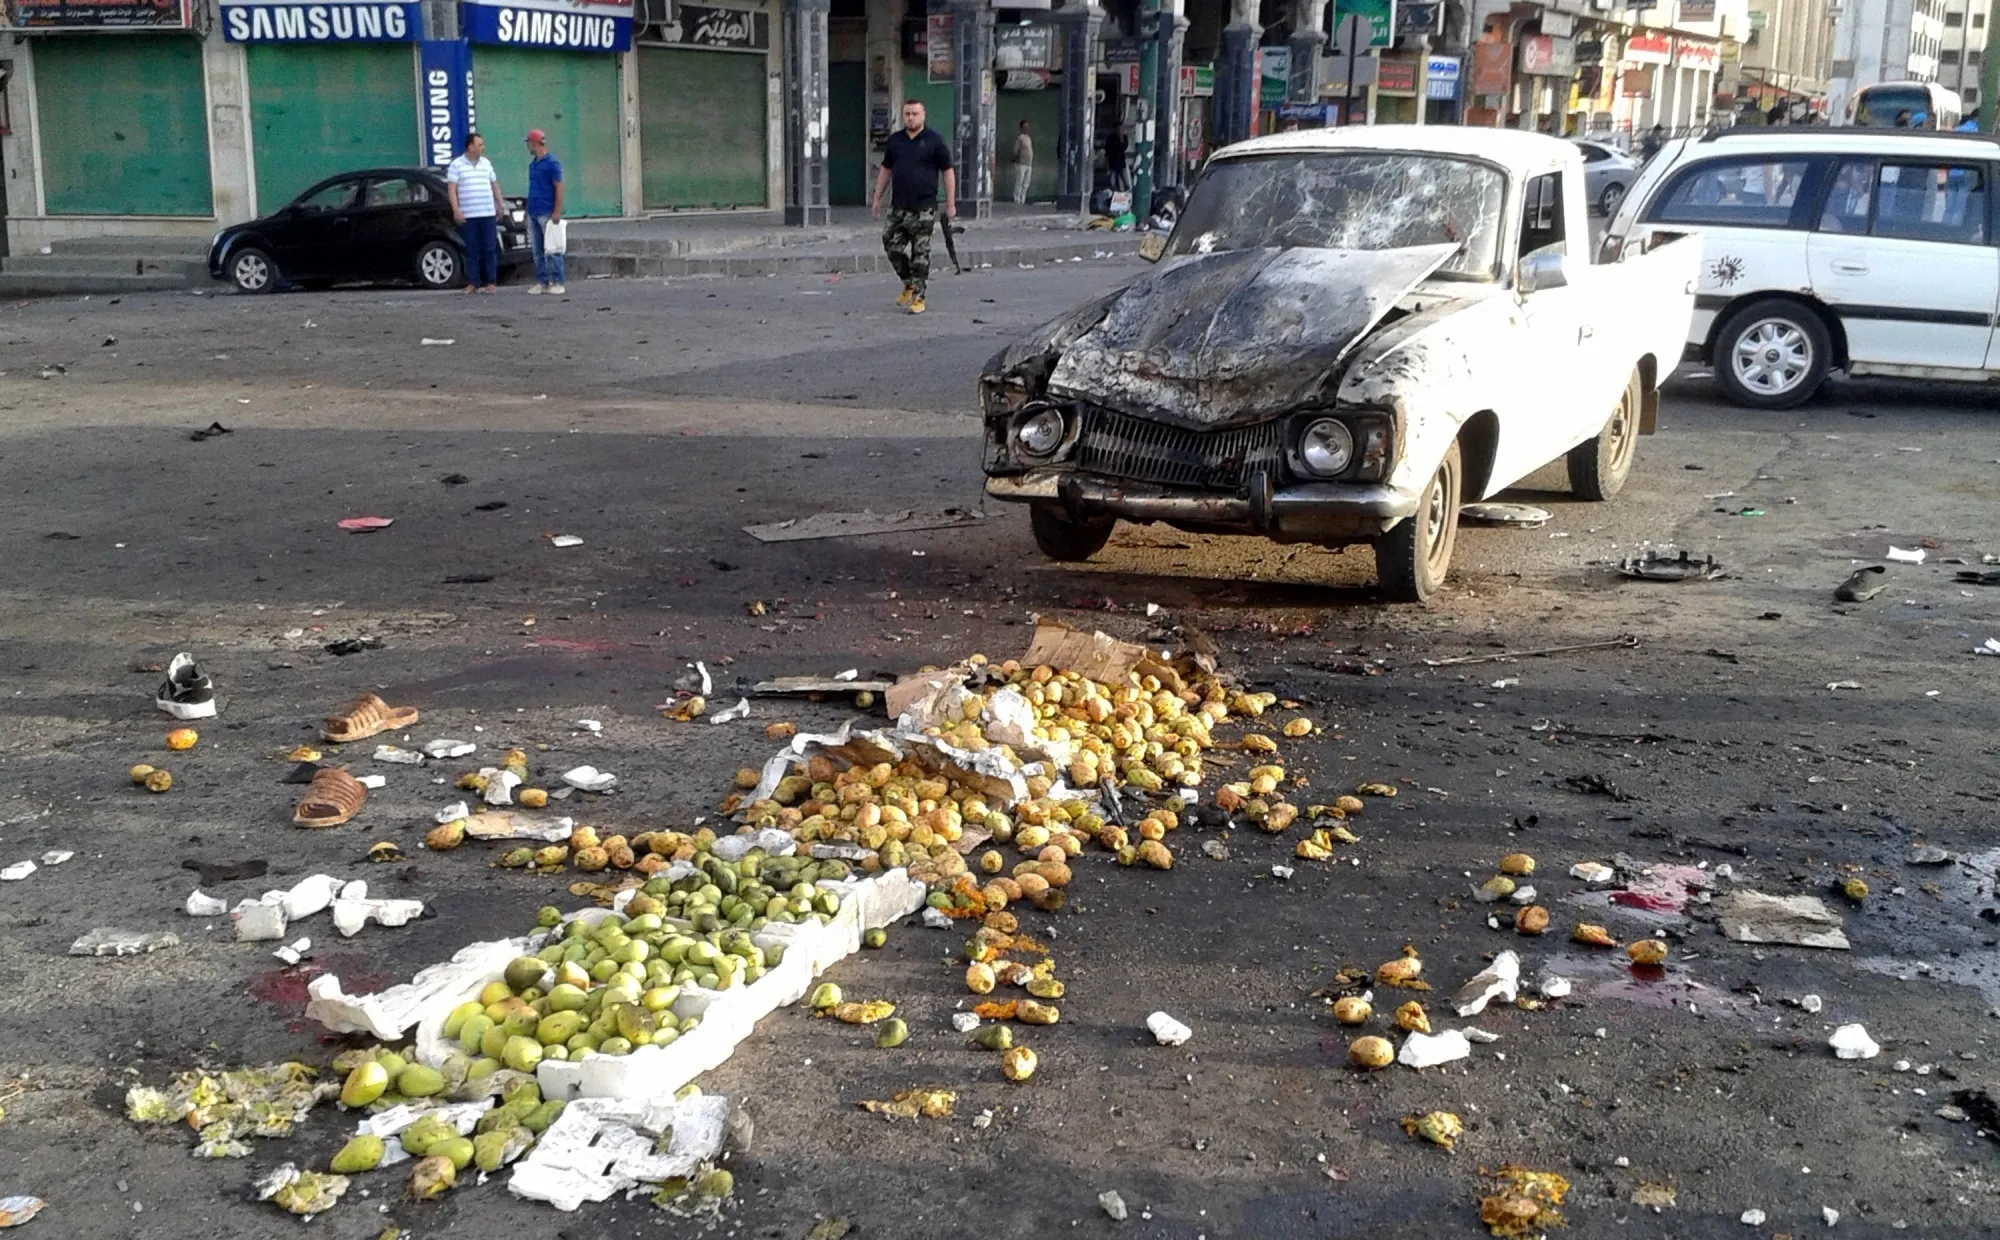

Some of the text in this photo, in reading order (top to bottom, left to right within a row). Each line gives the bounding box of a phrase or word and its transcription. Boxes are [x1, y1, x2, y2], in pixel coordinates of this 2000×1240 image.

[228, 5, 406, 41] SAMSUNG
[498, 8, 615, 48] SAMSUNG
[428, 70, 453, 165] MSUNG
